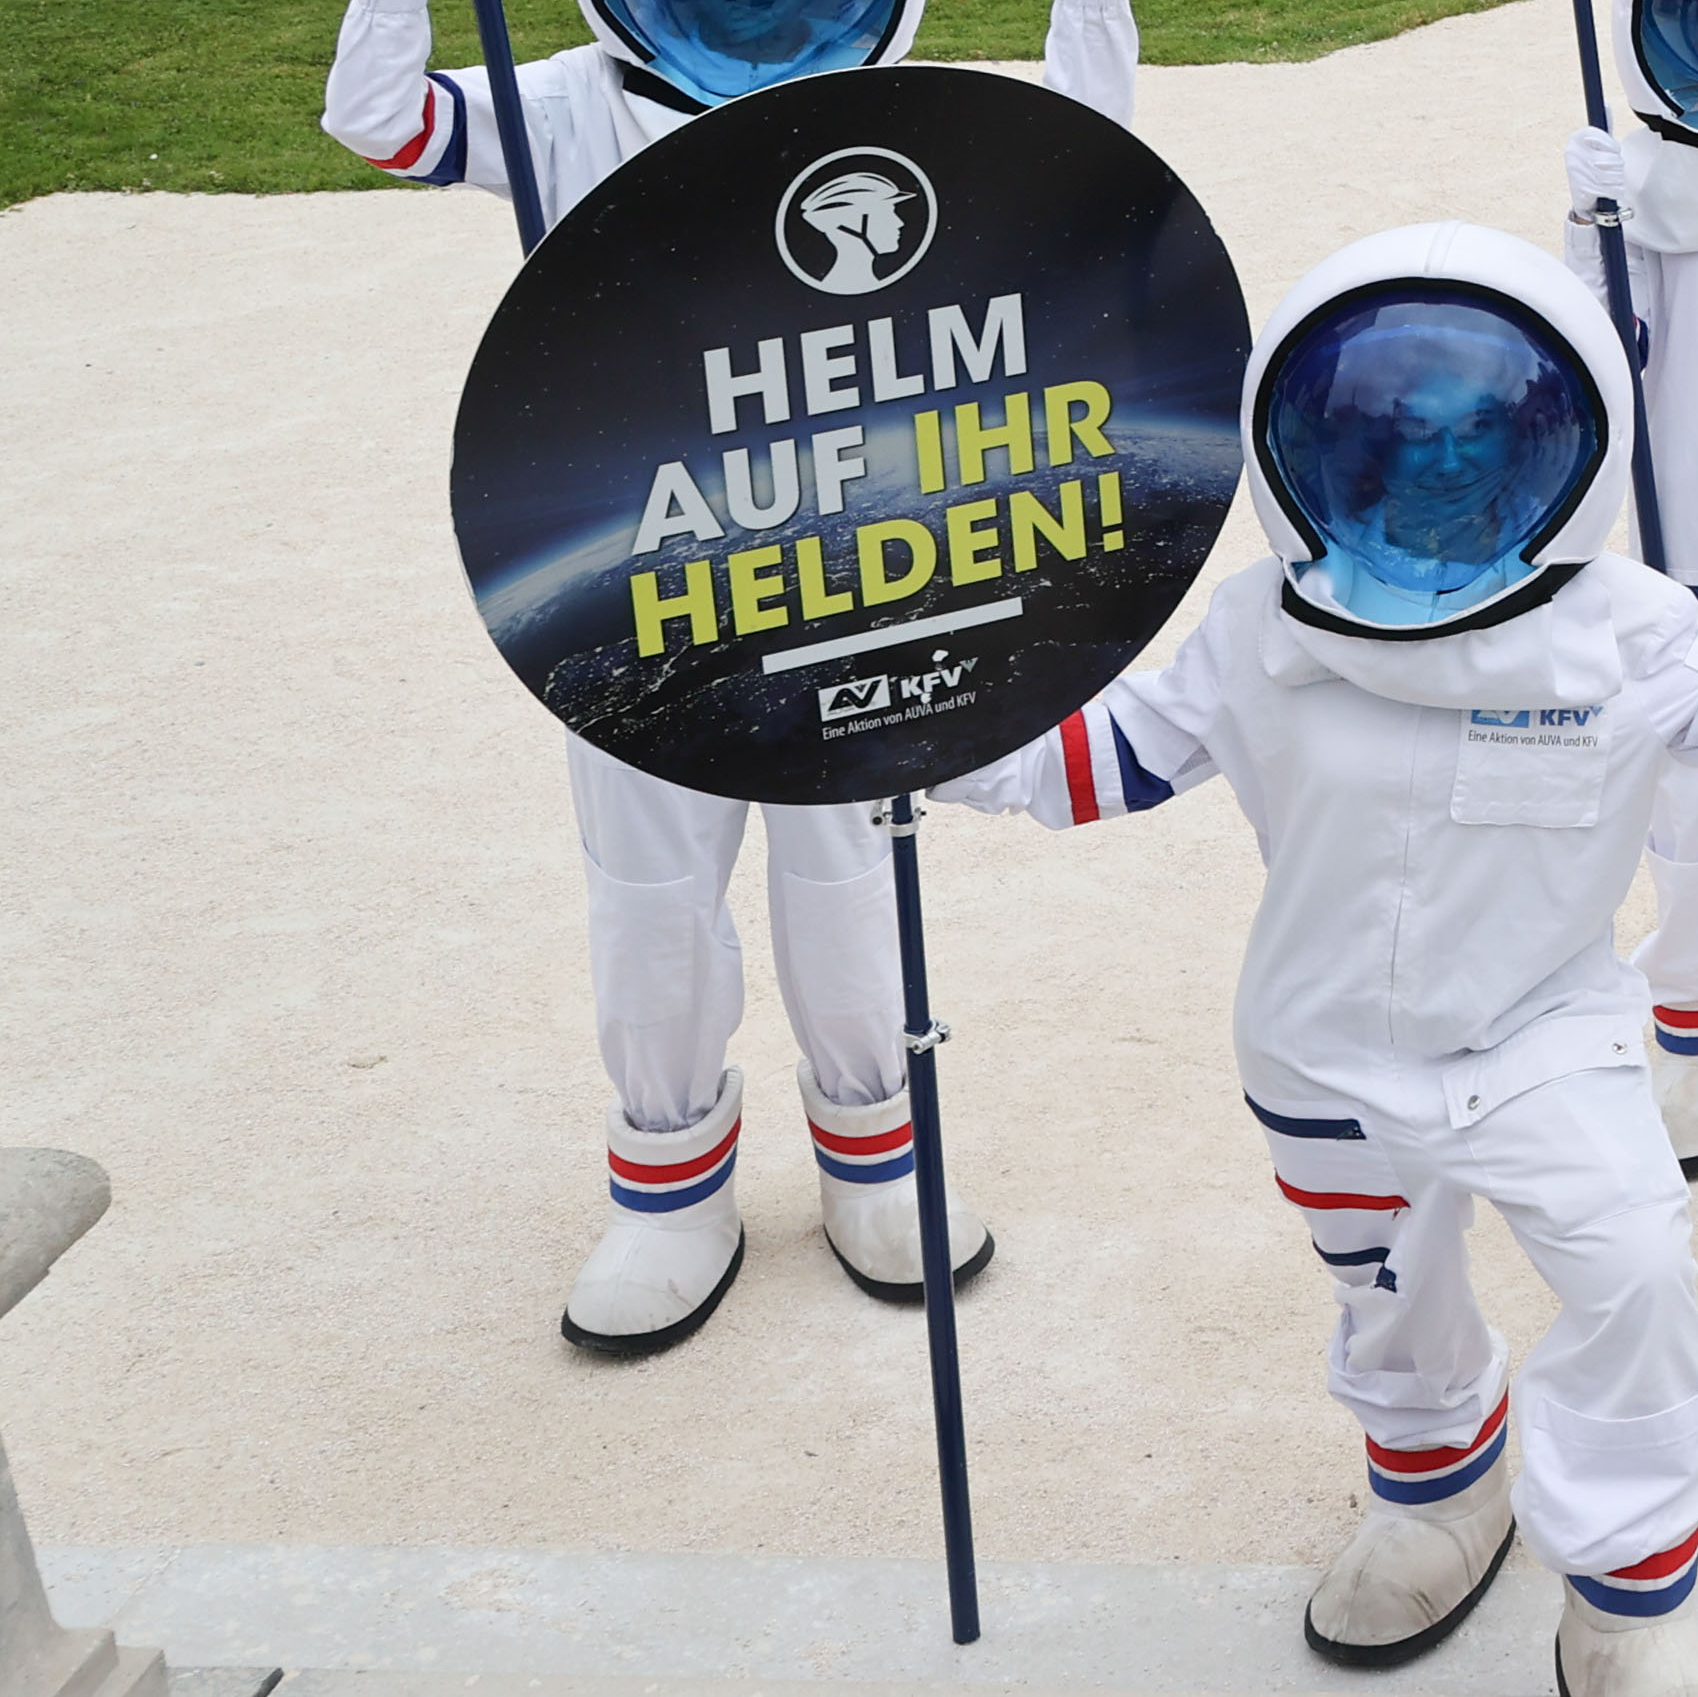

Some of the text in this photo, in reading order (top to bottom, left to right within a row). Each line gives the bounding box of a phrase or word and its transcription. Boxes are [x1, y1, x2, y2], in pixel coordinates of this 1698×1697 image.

[702, 292, 1027, 435] HELM
[631, 379, 1115, 556] AUF IHR
[629, 470, 1126, 659] HELDEN!
[900, 666, 962, 699] KFV
[822, 691, 976, 740] Eine Aktion von AUVA und KFV
[1468, 730, 1598, 747] Eine Aktion von AUVA und KFV
[1540, 709, 1590, 726] KFV
